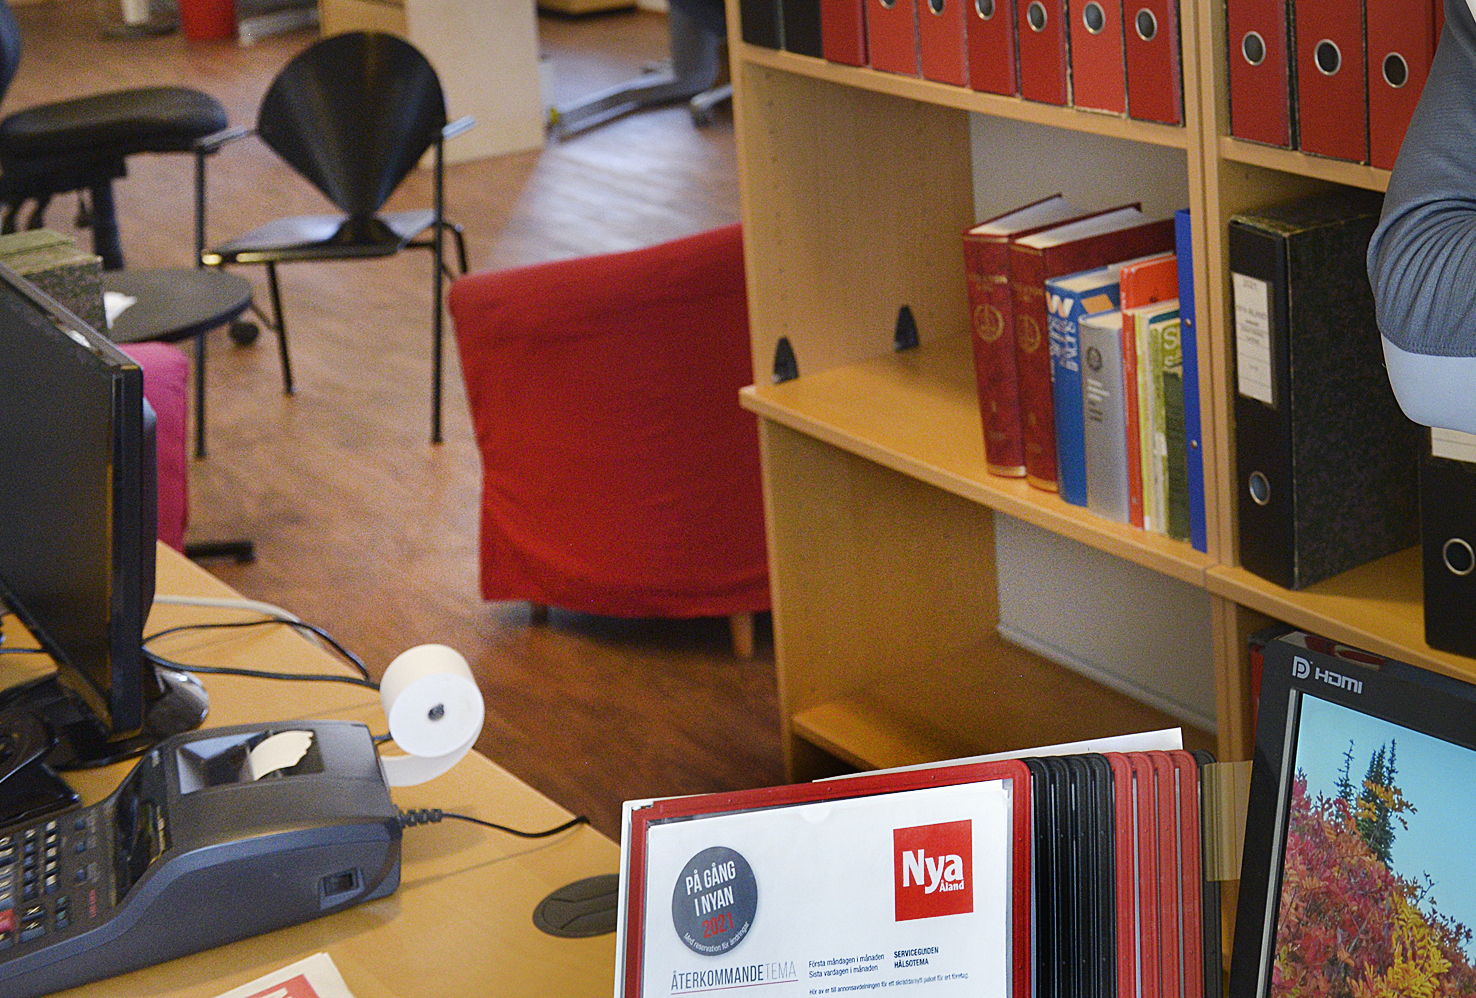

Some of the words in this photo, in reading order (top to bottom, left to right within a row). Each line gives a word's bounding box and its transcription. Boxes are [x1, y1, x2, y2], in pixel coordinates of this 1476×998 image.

[1315, 667, 1363, 694] HDMI
[686, 869, 702, 895] PÅ
[704, 861, 736, 888] GÅNG
[902, 849, 964, 894] Nya
[939, 879, 964, 892] Åland
[694, 898, 699, 916] I
[701, 886, 734, 914] NYAN
[702, 911, 733, 939] 2021
[684, 932, 695, 946] Med
[894, 946, 939, 958] SERVICEGUIDEN
[808, 959, 826, 967] Första
[827, 956, 855, 966] måndagen
[860, 953, 884, 962] månaden
[894, 958, 929, 968] HÄLSOTEMA
[824, 969, 849, 977] vardagen
[853, 965, 878, 973] månaden
